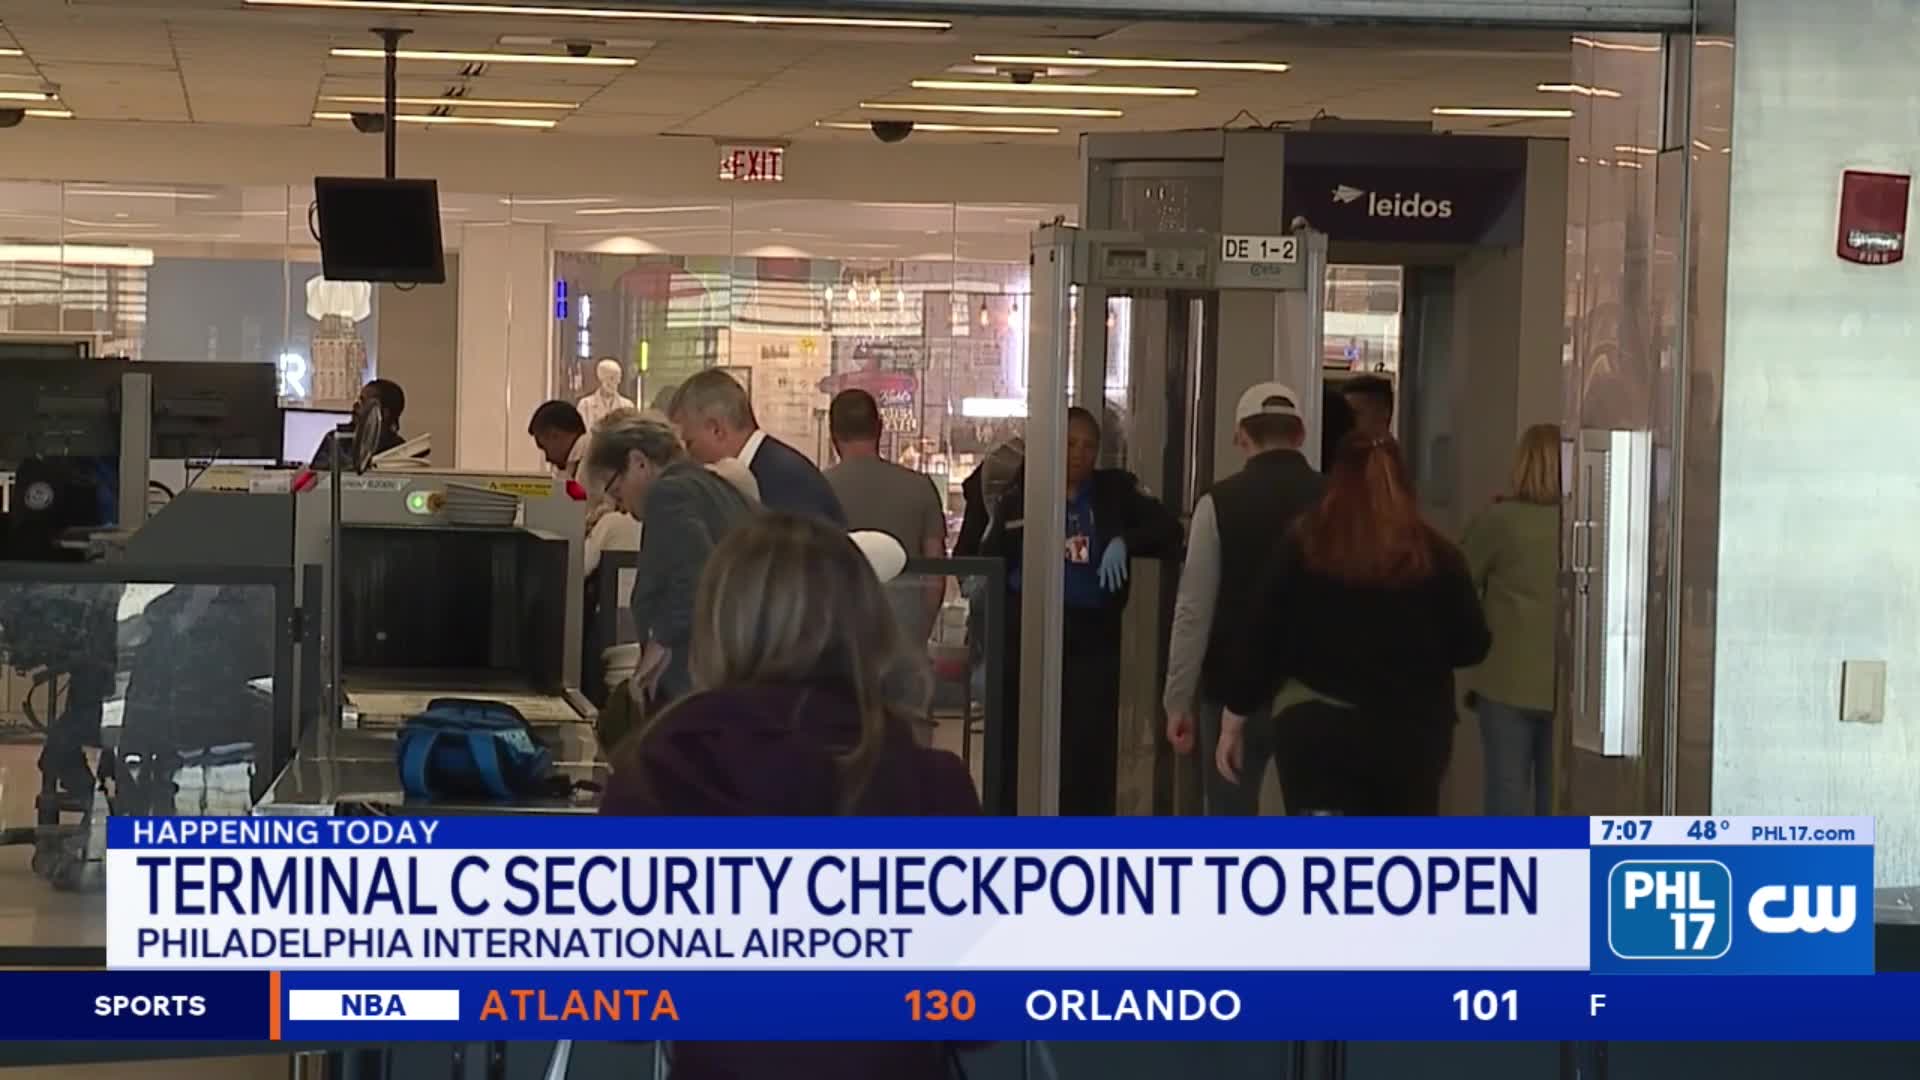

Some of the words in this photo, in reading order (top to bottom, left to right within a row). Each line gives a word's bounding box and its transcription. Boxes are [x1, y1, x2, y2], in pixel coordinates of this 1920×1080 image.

[733, 150, 780, 178] EXIT
[1368, 192, 1452, 217] leidos
[1226, 239, 1249, 258] DE
[1260, 240, 1294, 259] 1-2
